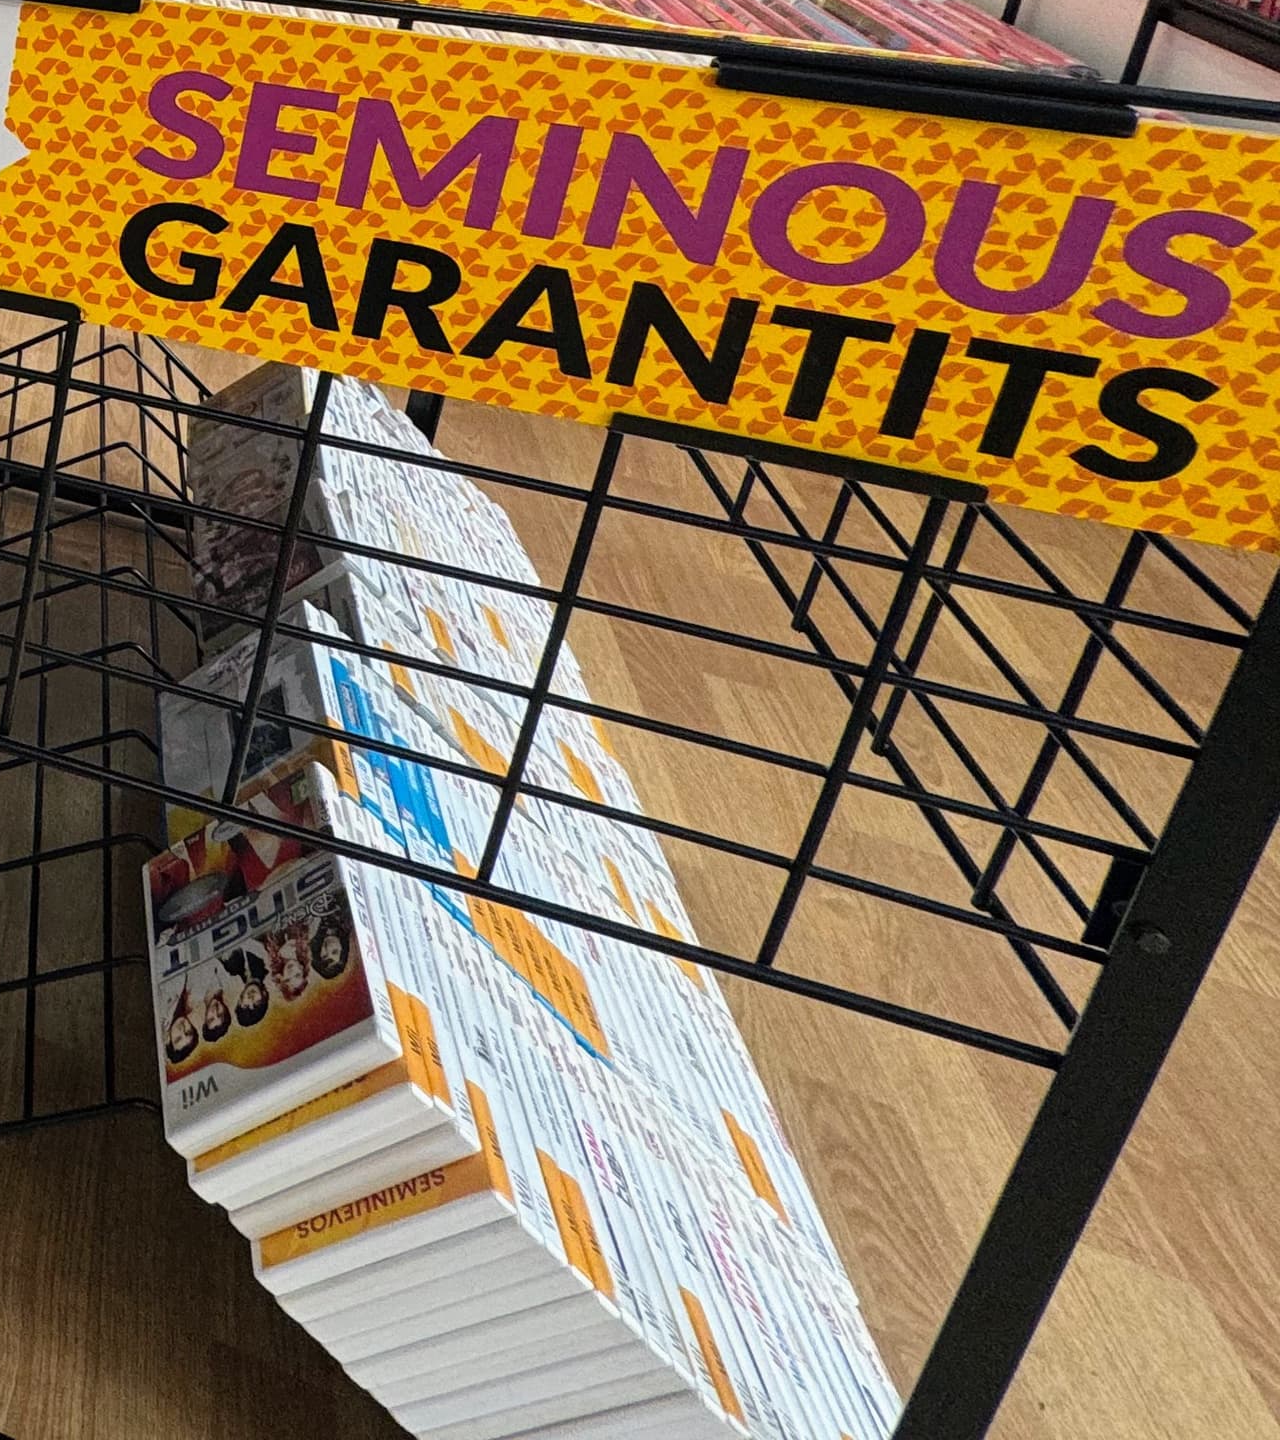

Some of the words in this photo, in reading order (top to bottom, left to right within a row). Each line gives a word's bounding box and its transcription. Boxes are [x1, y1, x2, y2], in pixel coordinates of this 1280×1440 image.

[132, 67, 1257, 341] SEMINOUS
[117, 200, 1221, 484] GARANTITS
[181, 1075, 219, 1110] Wii
[295, 1167, 447, 1243] SEMINUEVOS
